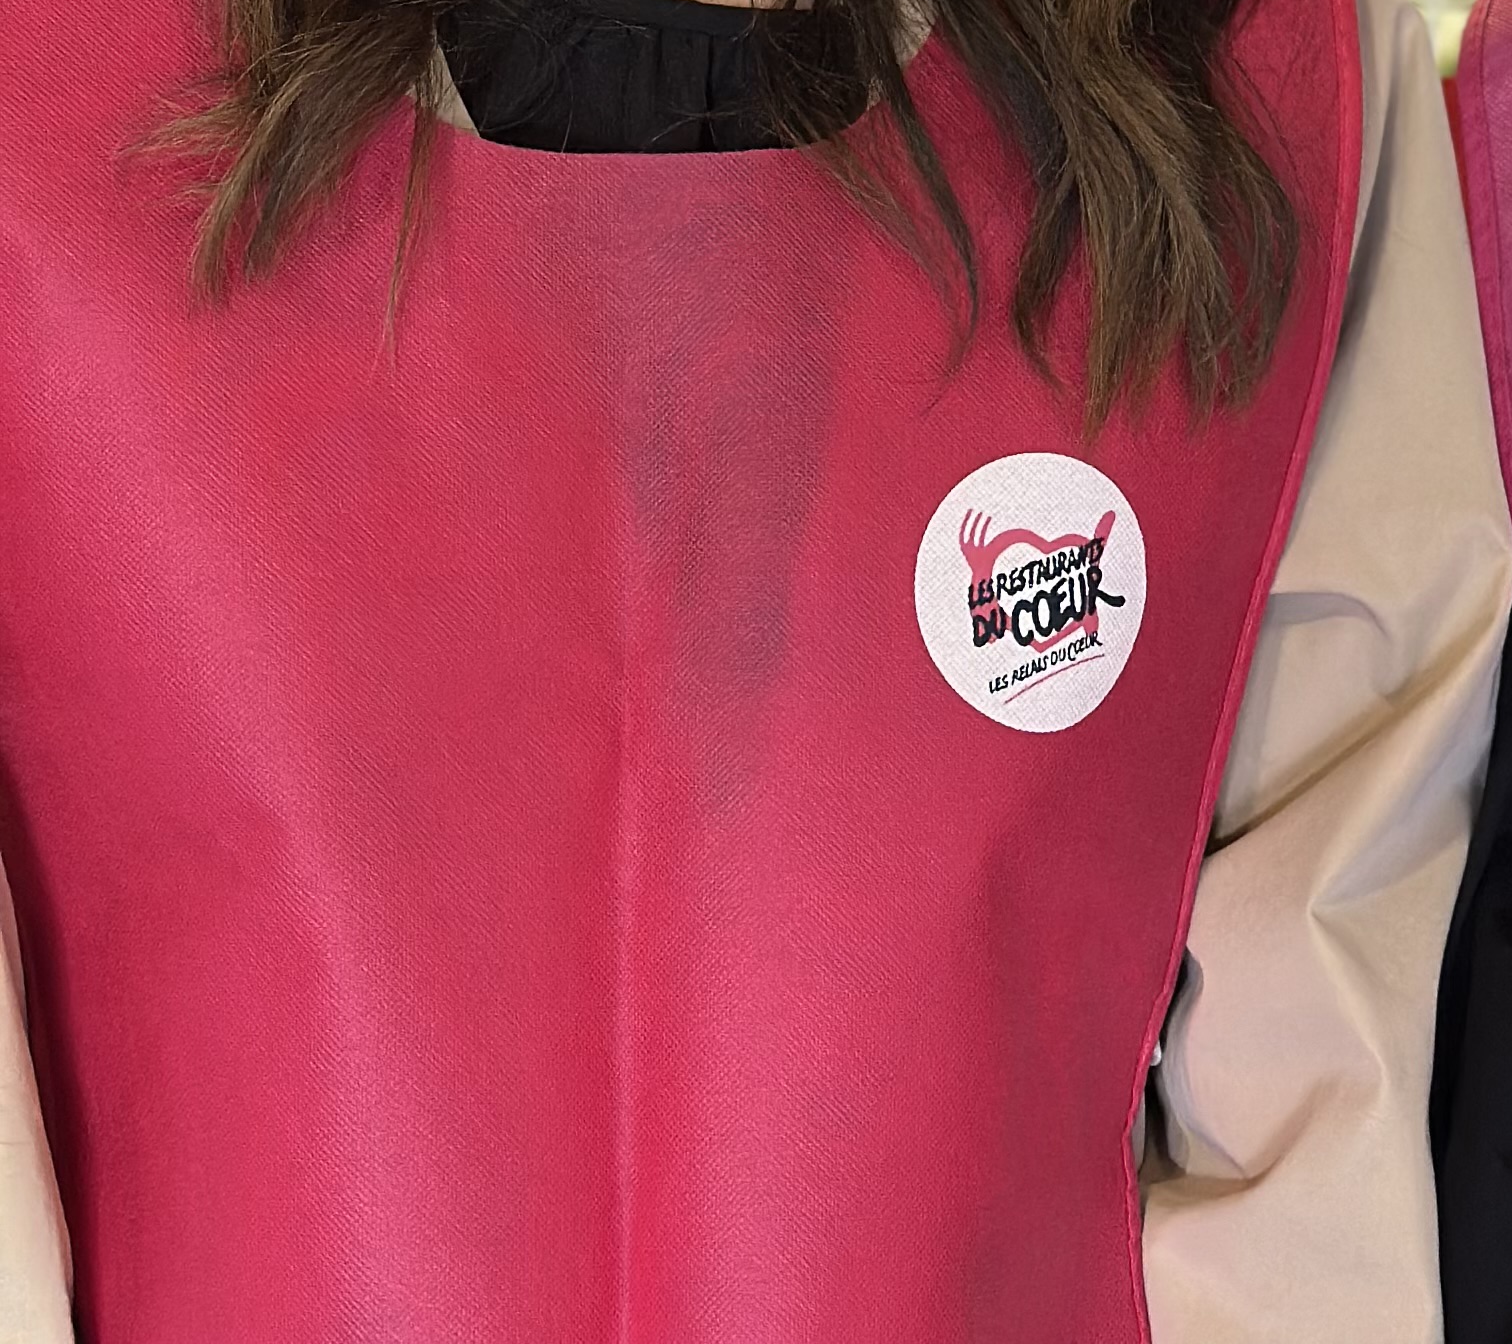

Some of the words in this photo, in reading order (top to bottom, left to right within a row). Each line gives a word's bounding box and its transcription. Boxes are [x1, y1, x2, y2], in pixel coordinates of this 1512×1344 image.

[968, 578, 996, 610] LES
[996, 537, 1105, 601] RESTAURANTS
[972, 606, 1007, 647] DU
[988, 676, 1009, 695] LES
[1011, 655, 1050, 687] RELAIS
[1050, 647, 1067, 666] DU
